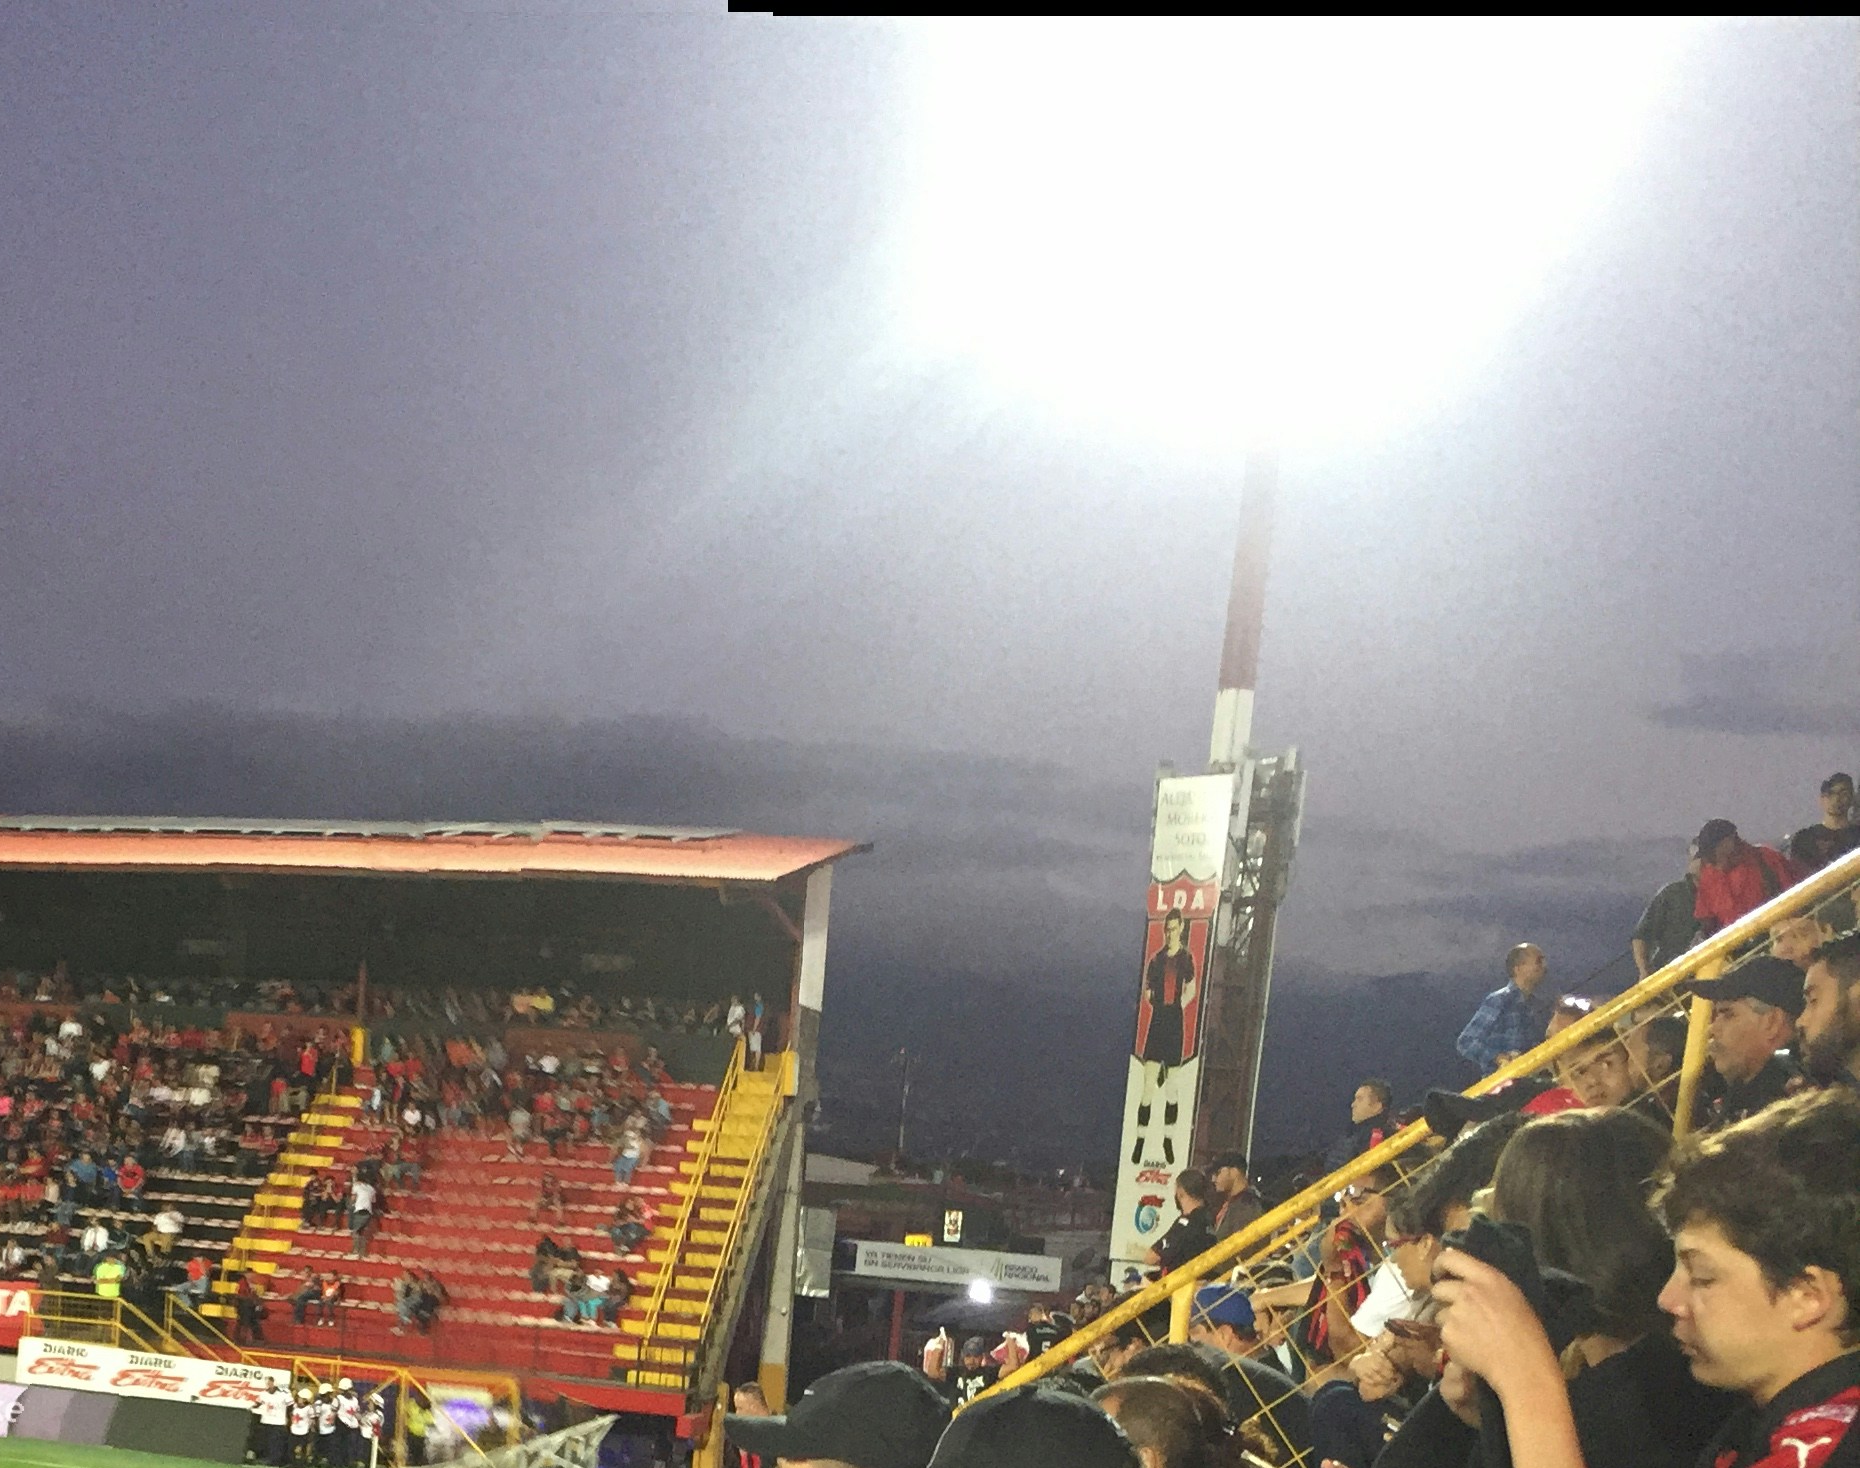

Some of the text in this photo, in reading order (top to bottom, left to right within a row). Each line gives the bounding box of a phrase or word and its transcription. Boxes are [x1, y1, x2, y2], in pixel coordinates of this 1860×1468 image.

[1156, 885, 1205, 911] LDA
[215, 1365, 264, 1381] DIARIO
[199, 1380, 266, 1403] Extr
